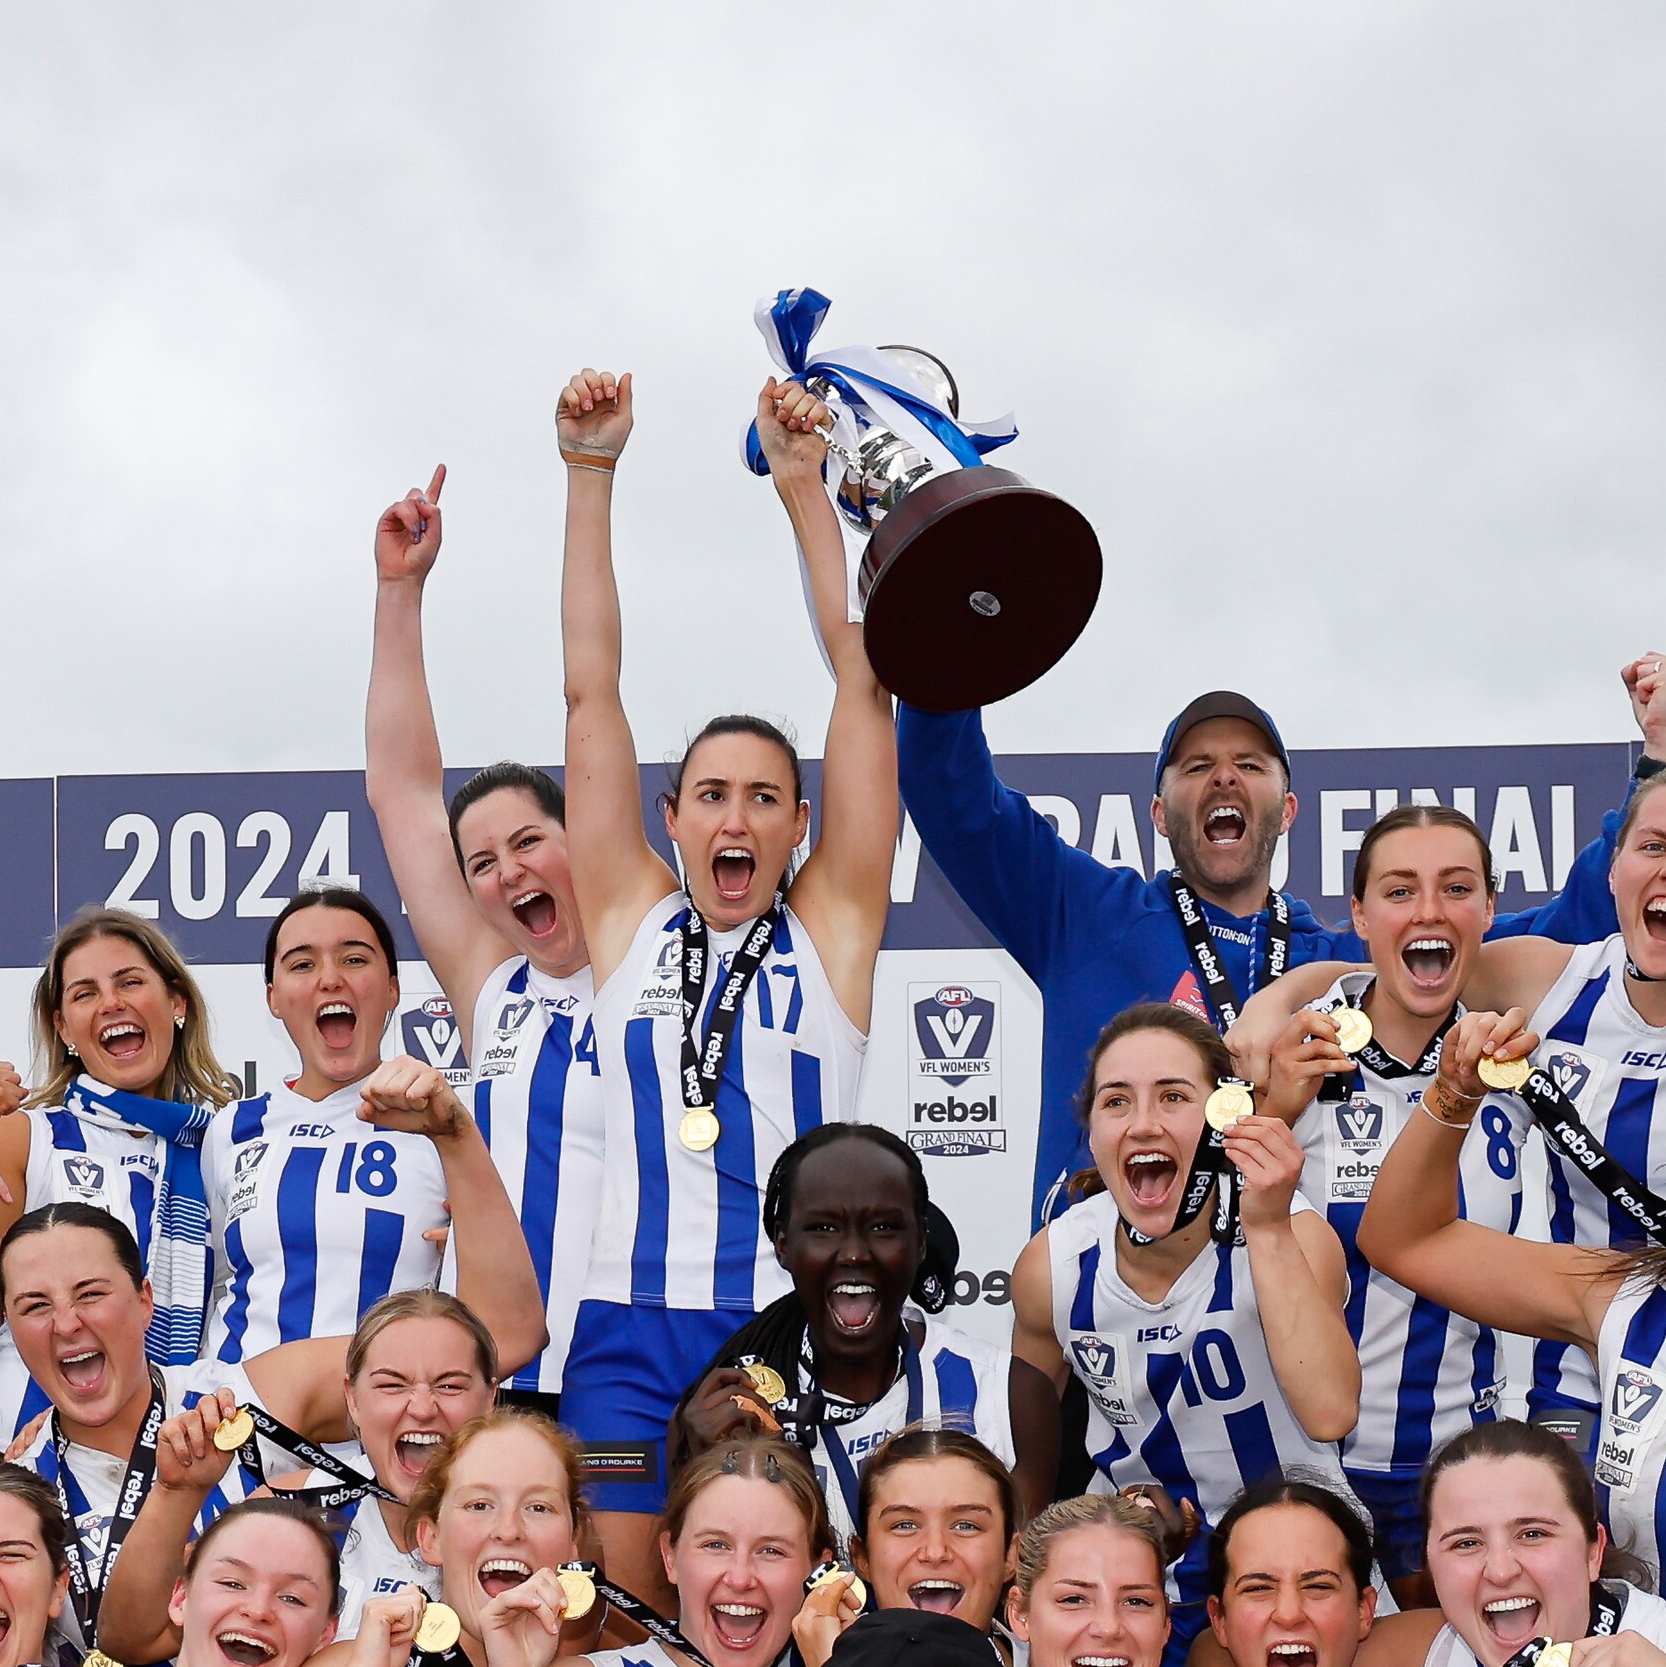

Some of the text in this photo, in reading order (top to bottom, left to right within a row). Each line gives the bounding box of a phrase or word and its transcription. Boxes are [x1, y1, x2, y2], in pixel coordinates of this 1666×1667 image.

[104, 810, 361, 921] 2024
[1176, 888, 1199, 926] rebel
[744, 920, 771, 957] rebel
[1269, 938, 1287, 976] rebel
[688, 947, 703, 985] rebel
[1196, 941, 1225, 985] rebel
[641, 986, 682, 1001] rebel
[719, 971, 744, 1011] rebel
[756, 964, 804, 1035] 17
[938, 989, 970, 1003] AFL
[701, 1031, 724, 1080] rebel
[920, 1061, 990, 1073] VFL WOMEN'S
[1621, 1051, 1659, 1069] ISC
[914, 1096, 997, 1123] rebel
[289, 1124, 323, 1139] ISC
[911, 1131, 1004, 1150] GRAND FINAL
[942, 1145, 969, 1156] 2024
[1480, 1104, 1517, 1180] 8
[1554, 1121, 1606, 1169] rebel
[336, 1141, 397, 1198] 18
[1185, 1170, 1212, 1214] rebel
[1612, 1185, 1663, 1232] rebel
[1137, 1327, 1172, 1343] ISC
[1179, 1327, 1247, 1408] 10
[141, 1401, 164, 1449] rebel
[293, 1441, 343, 1475] rebel
[119, 1470, 143, 1520] rebel
[596, 1585, 636, 1609] rebel
[642, 1617, 679, 1644] rebel
